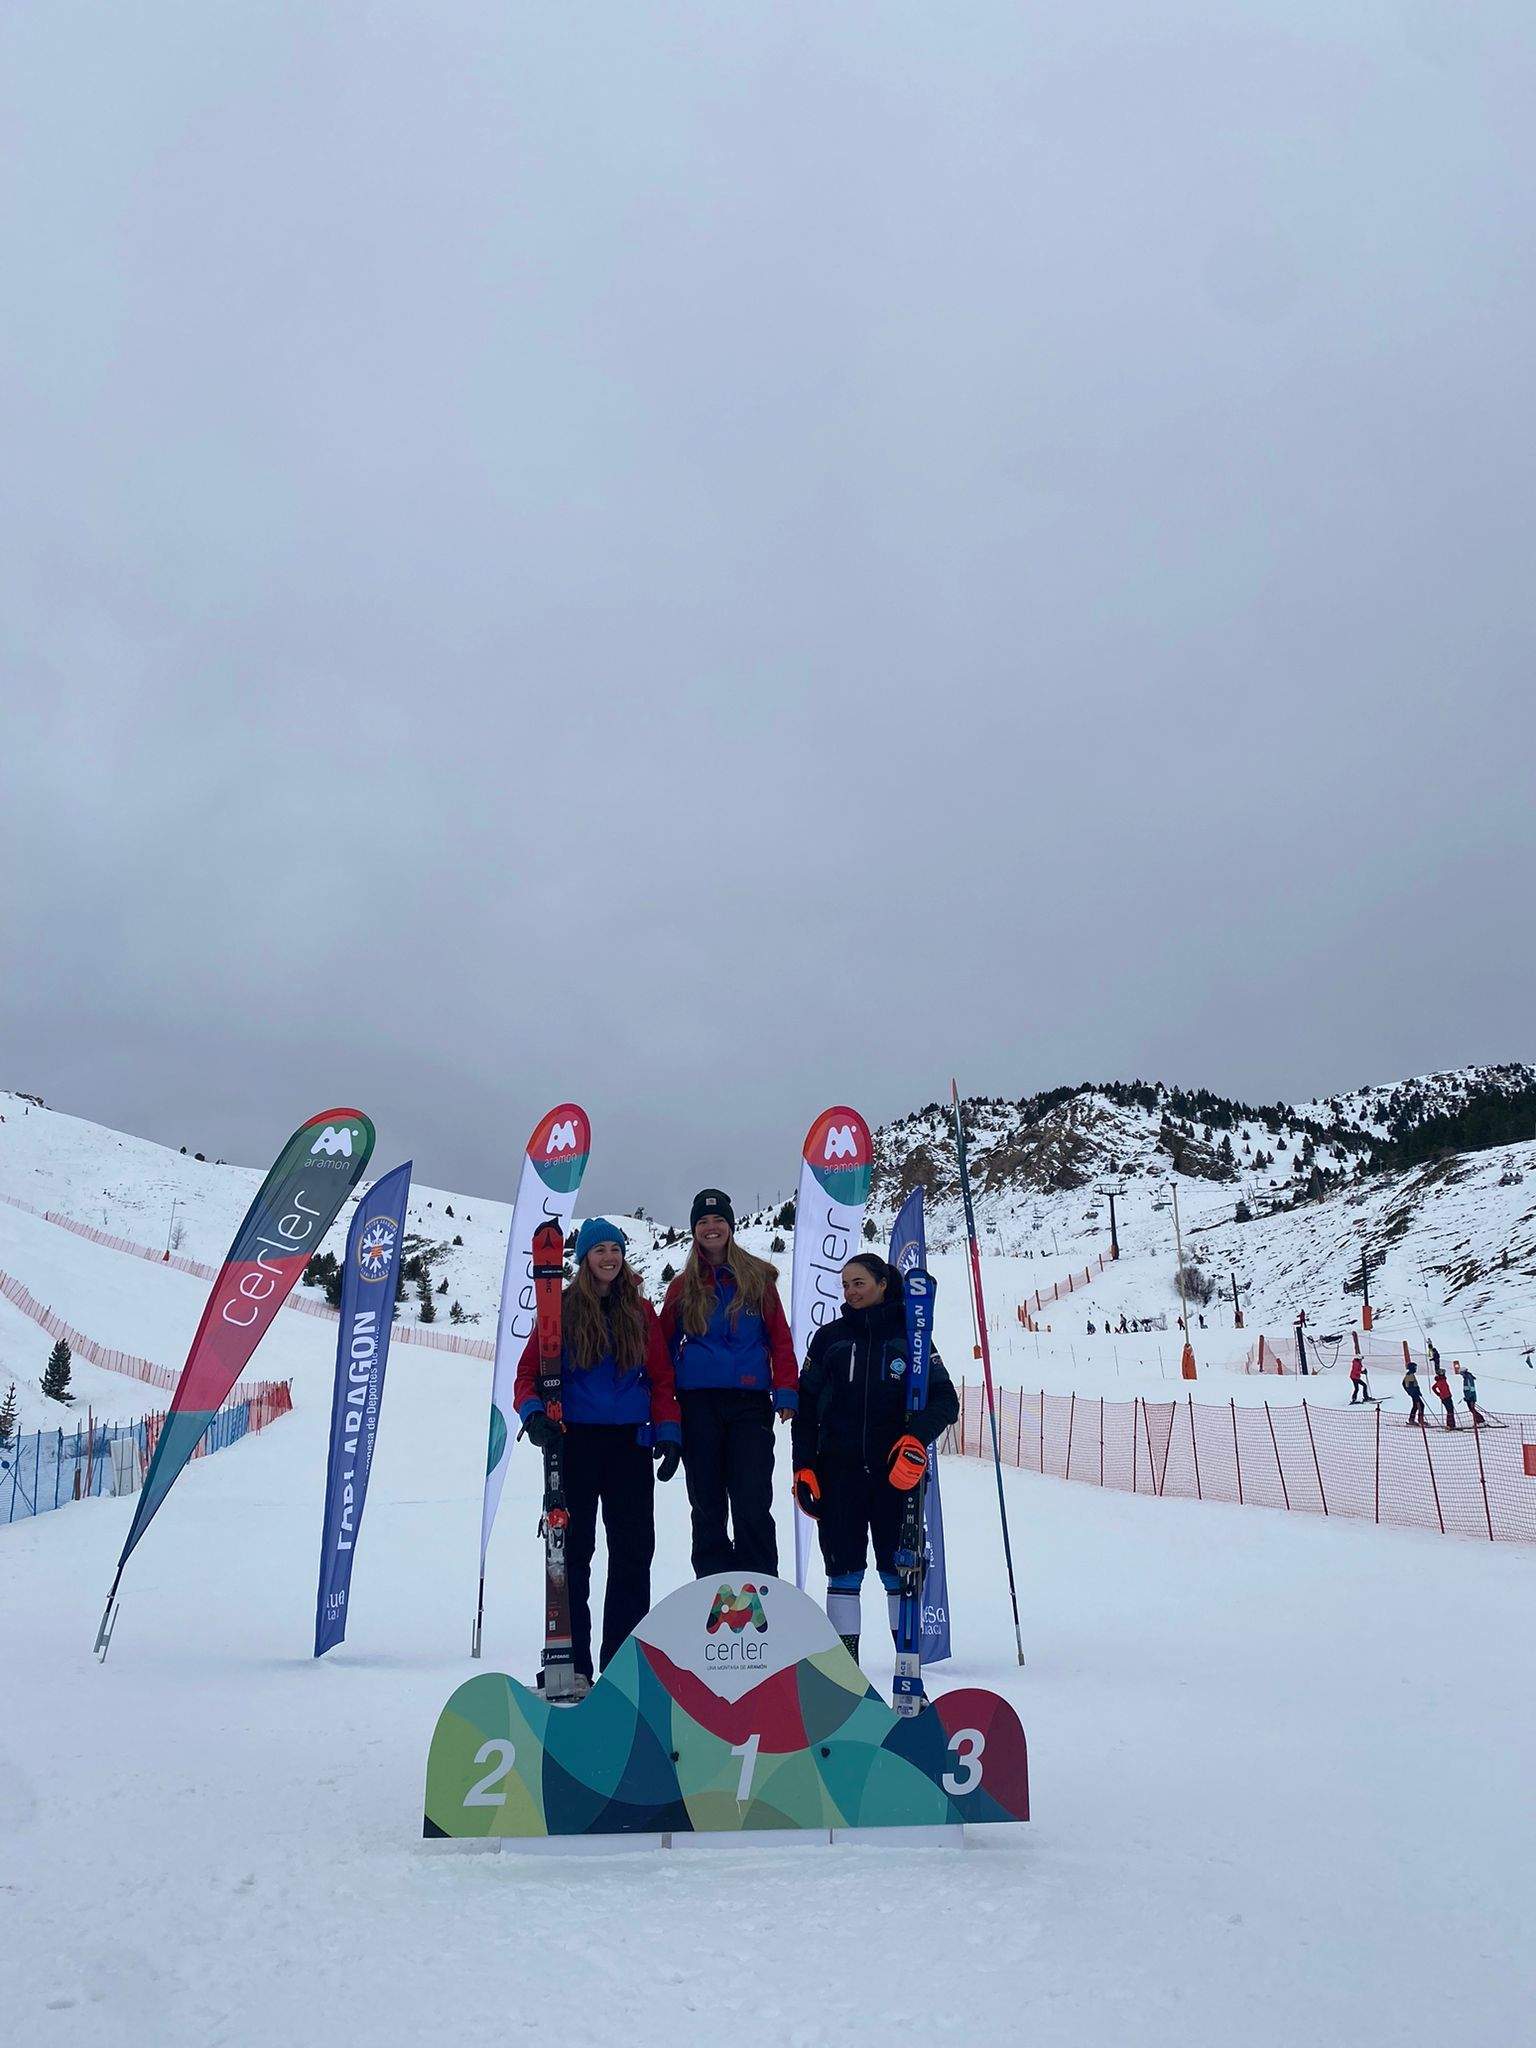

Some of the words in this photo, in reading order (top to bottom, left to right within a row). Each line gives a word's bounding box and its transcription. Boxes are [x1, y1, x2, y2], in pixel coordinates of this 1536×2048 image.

[304, 1158, 350, 1170] aramon
[824, 1162, 860, 1175] aramon
[222, 1190, 320, 1327] cerler
[366, 1367, 378, 1414] Deportes
[704, 1636, 769, 1661] cerler
[463, 1739, 516, 1806] 2
[730, 1734, 761, 1800] 1
[941, 1728, 986, 1796] 3
